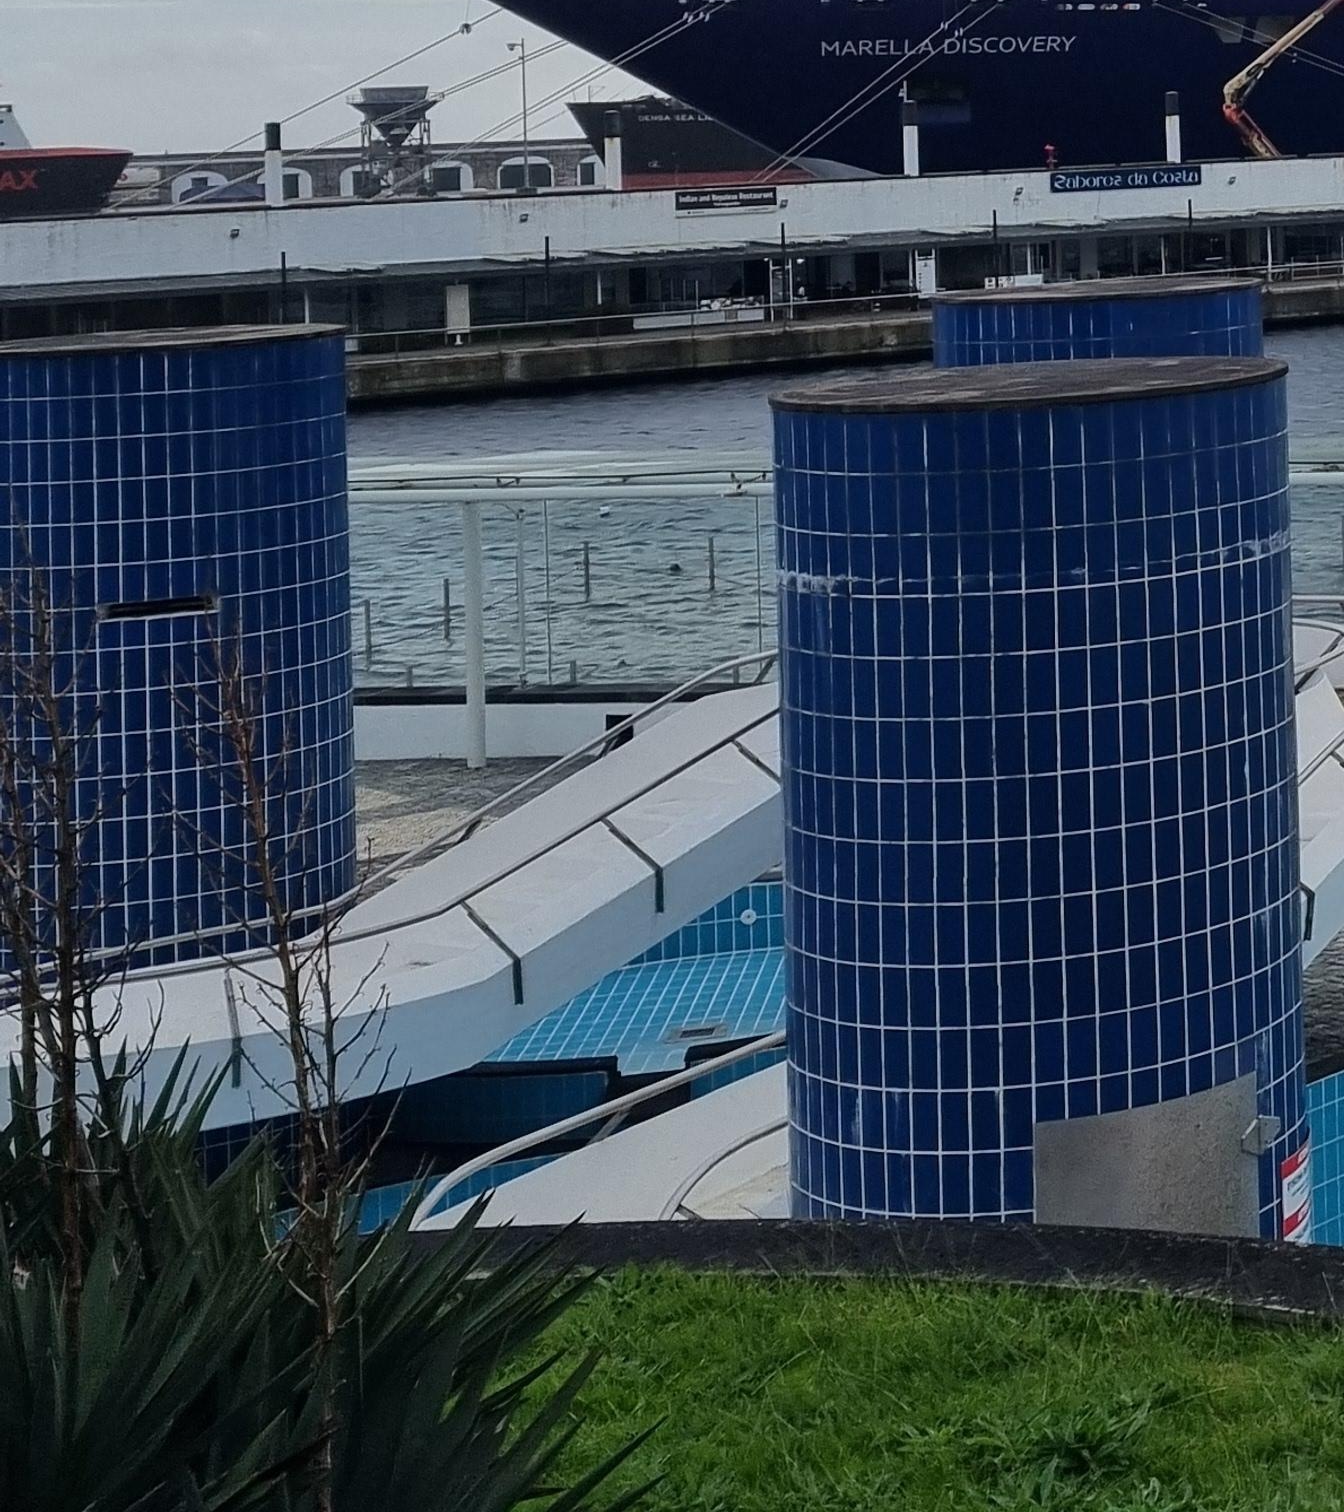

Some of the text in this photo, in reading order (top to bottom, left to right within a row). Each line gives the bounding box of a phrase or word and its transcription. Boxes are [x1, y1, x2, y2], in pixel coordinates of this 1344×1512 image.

[820, 35, 1077, 57] MARELLA DISCOVERY
[1054, 169, 1198, 189] Sabores da Costa
